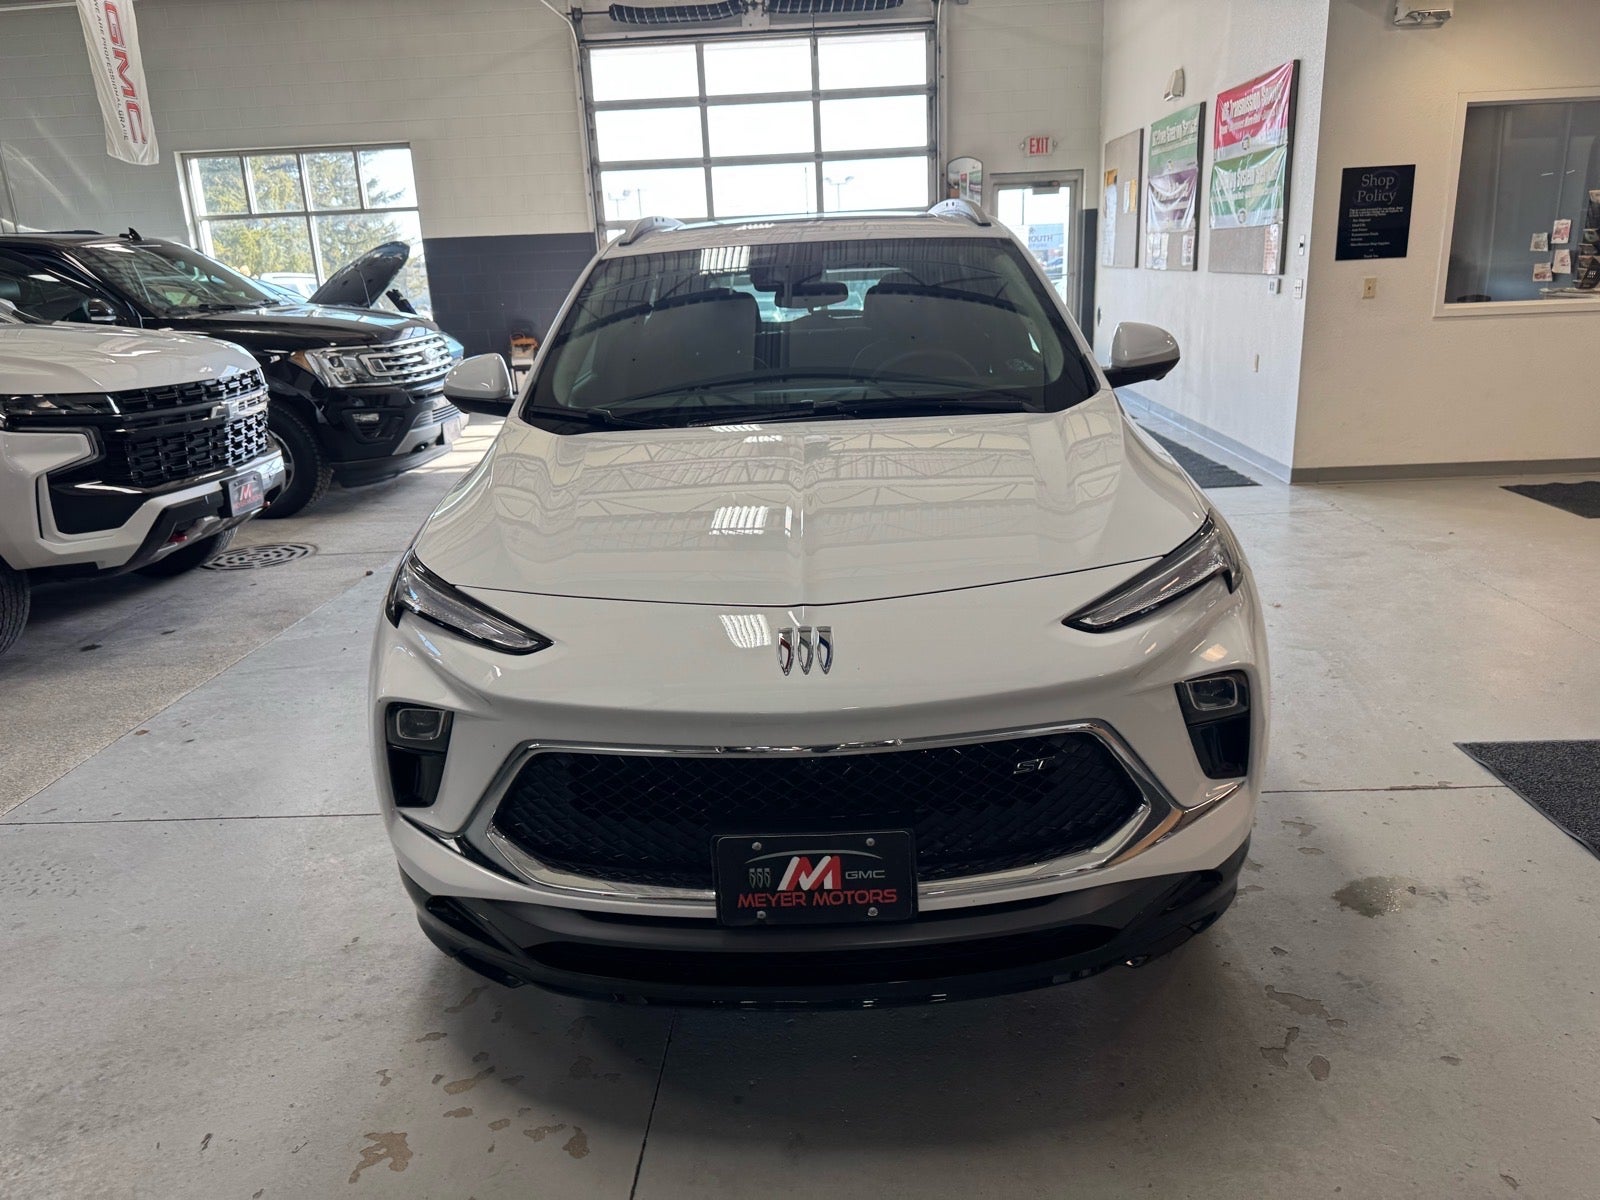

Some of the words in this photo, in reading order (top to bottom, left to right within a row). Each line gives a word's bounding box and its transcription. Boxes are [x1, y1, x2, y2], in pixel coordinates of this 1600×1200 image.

[104, 1, 148, 144] GMC
[1029, 137, 1050, 154] EXIT
[1361, 174, 1395, 189] Shop
[1357, 189, 1397, 205] Policy
[777, 855, 842, 891] M
[845, 870, 886, 880] GMC
[737, 892, 806, 908] MEYER
[812, 889, 898, 906] MOTORS
